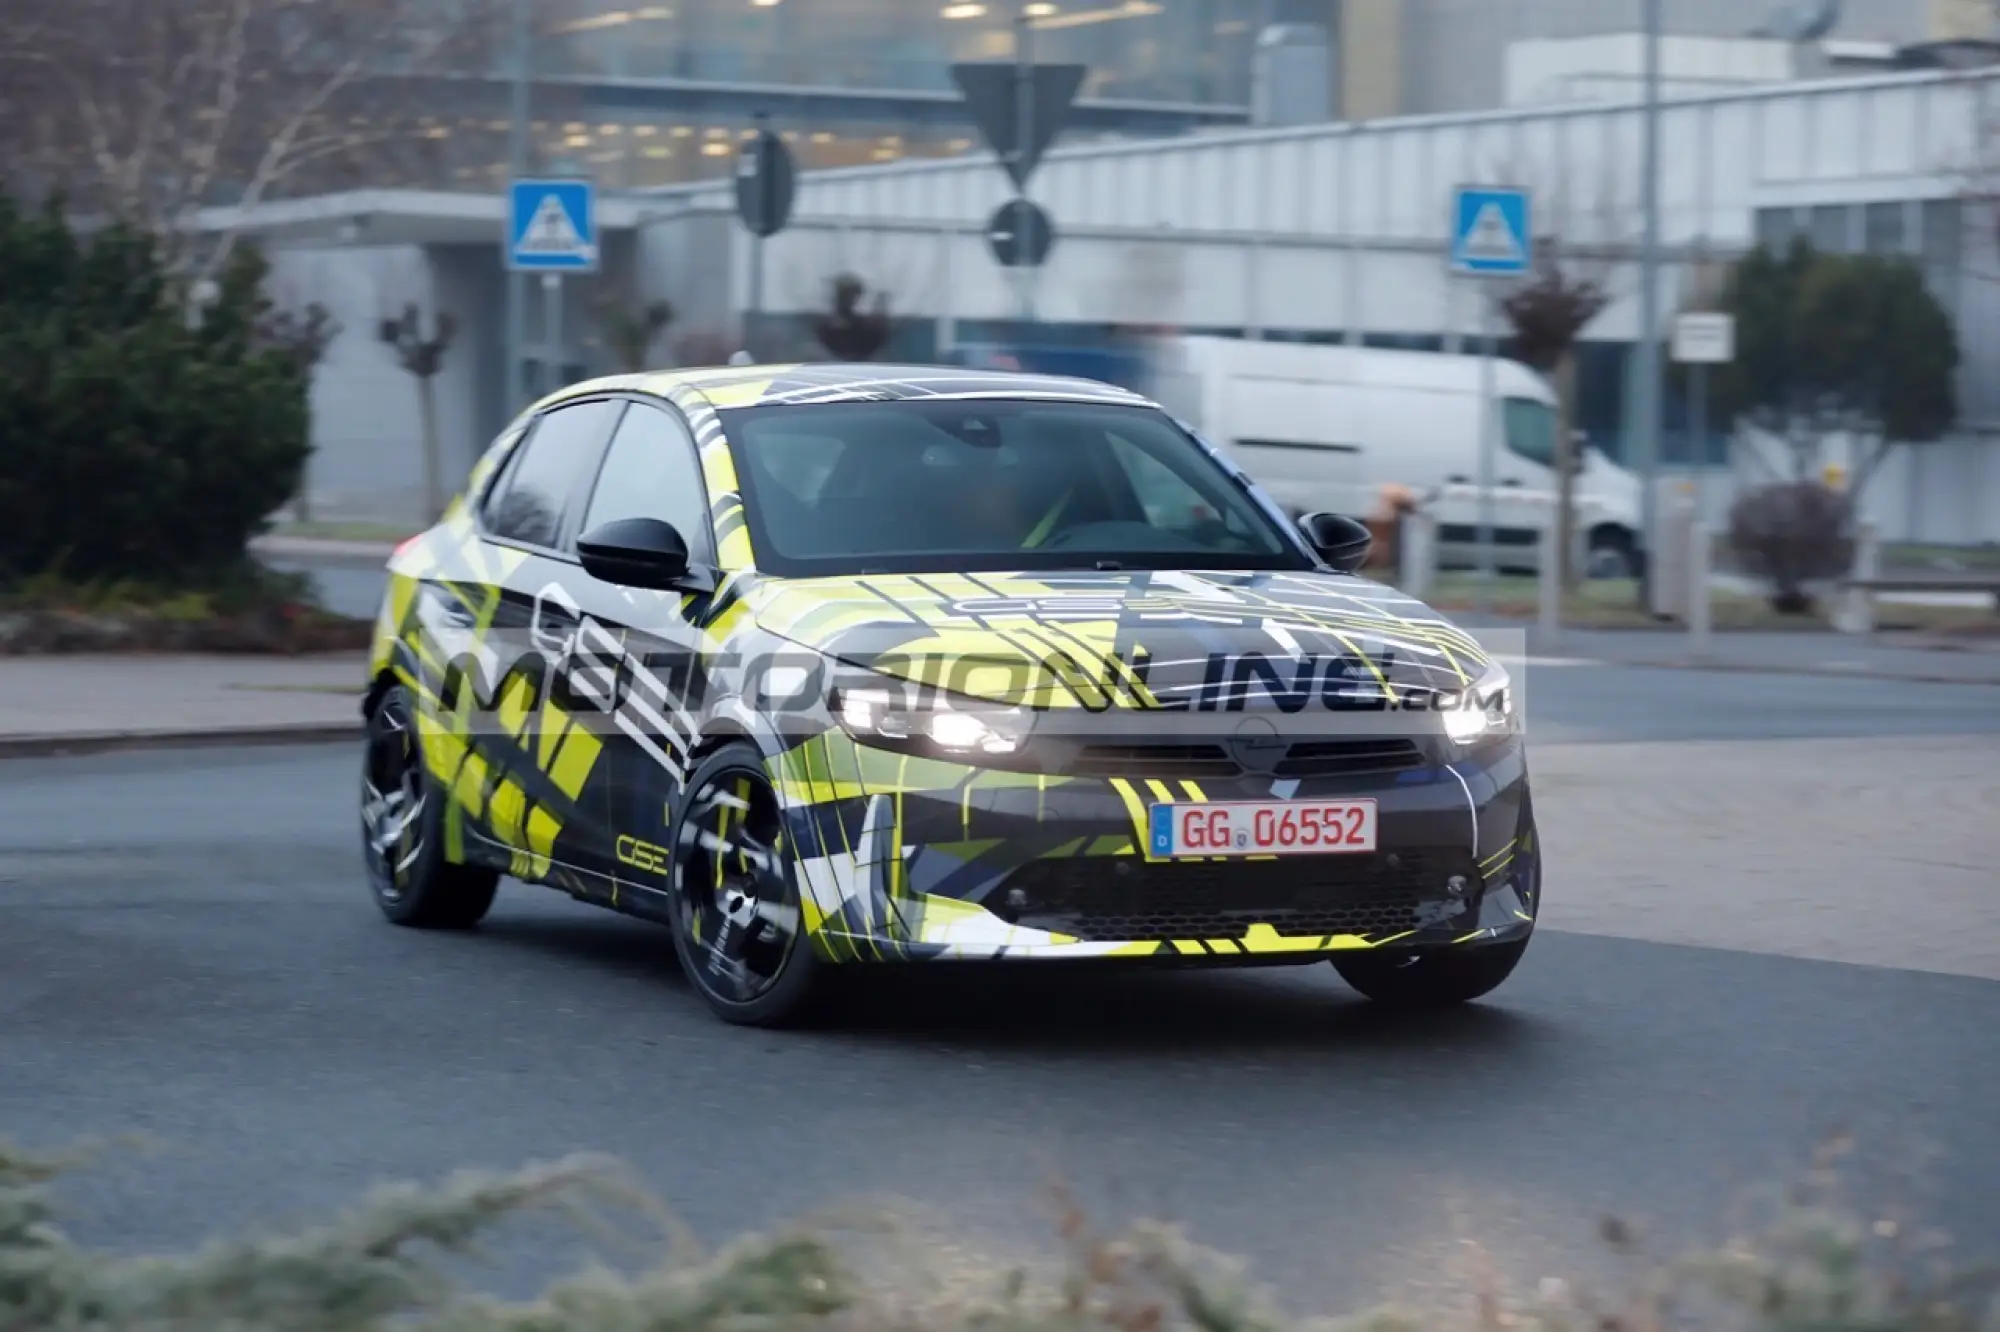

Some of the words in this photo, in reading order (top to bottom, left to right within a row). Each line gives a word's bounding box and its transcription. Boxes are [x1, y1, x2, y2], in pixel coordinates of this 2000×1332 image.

[1183, 810, 1229, 848] GG
[1254, 806, 1365, 847] 06552
[616, 834, 669, 876] GSE
